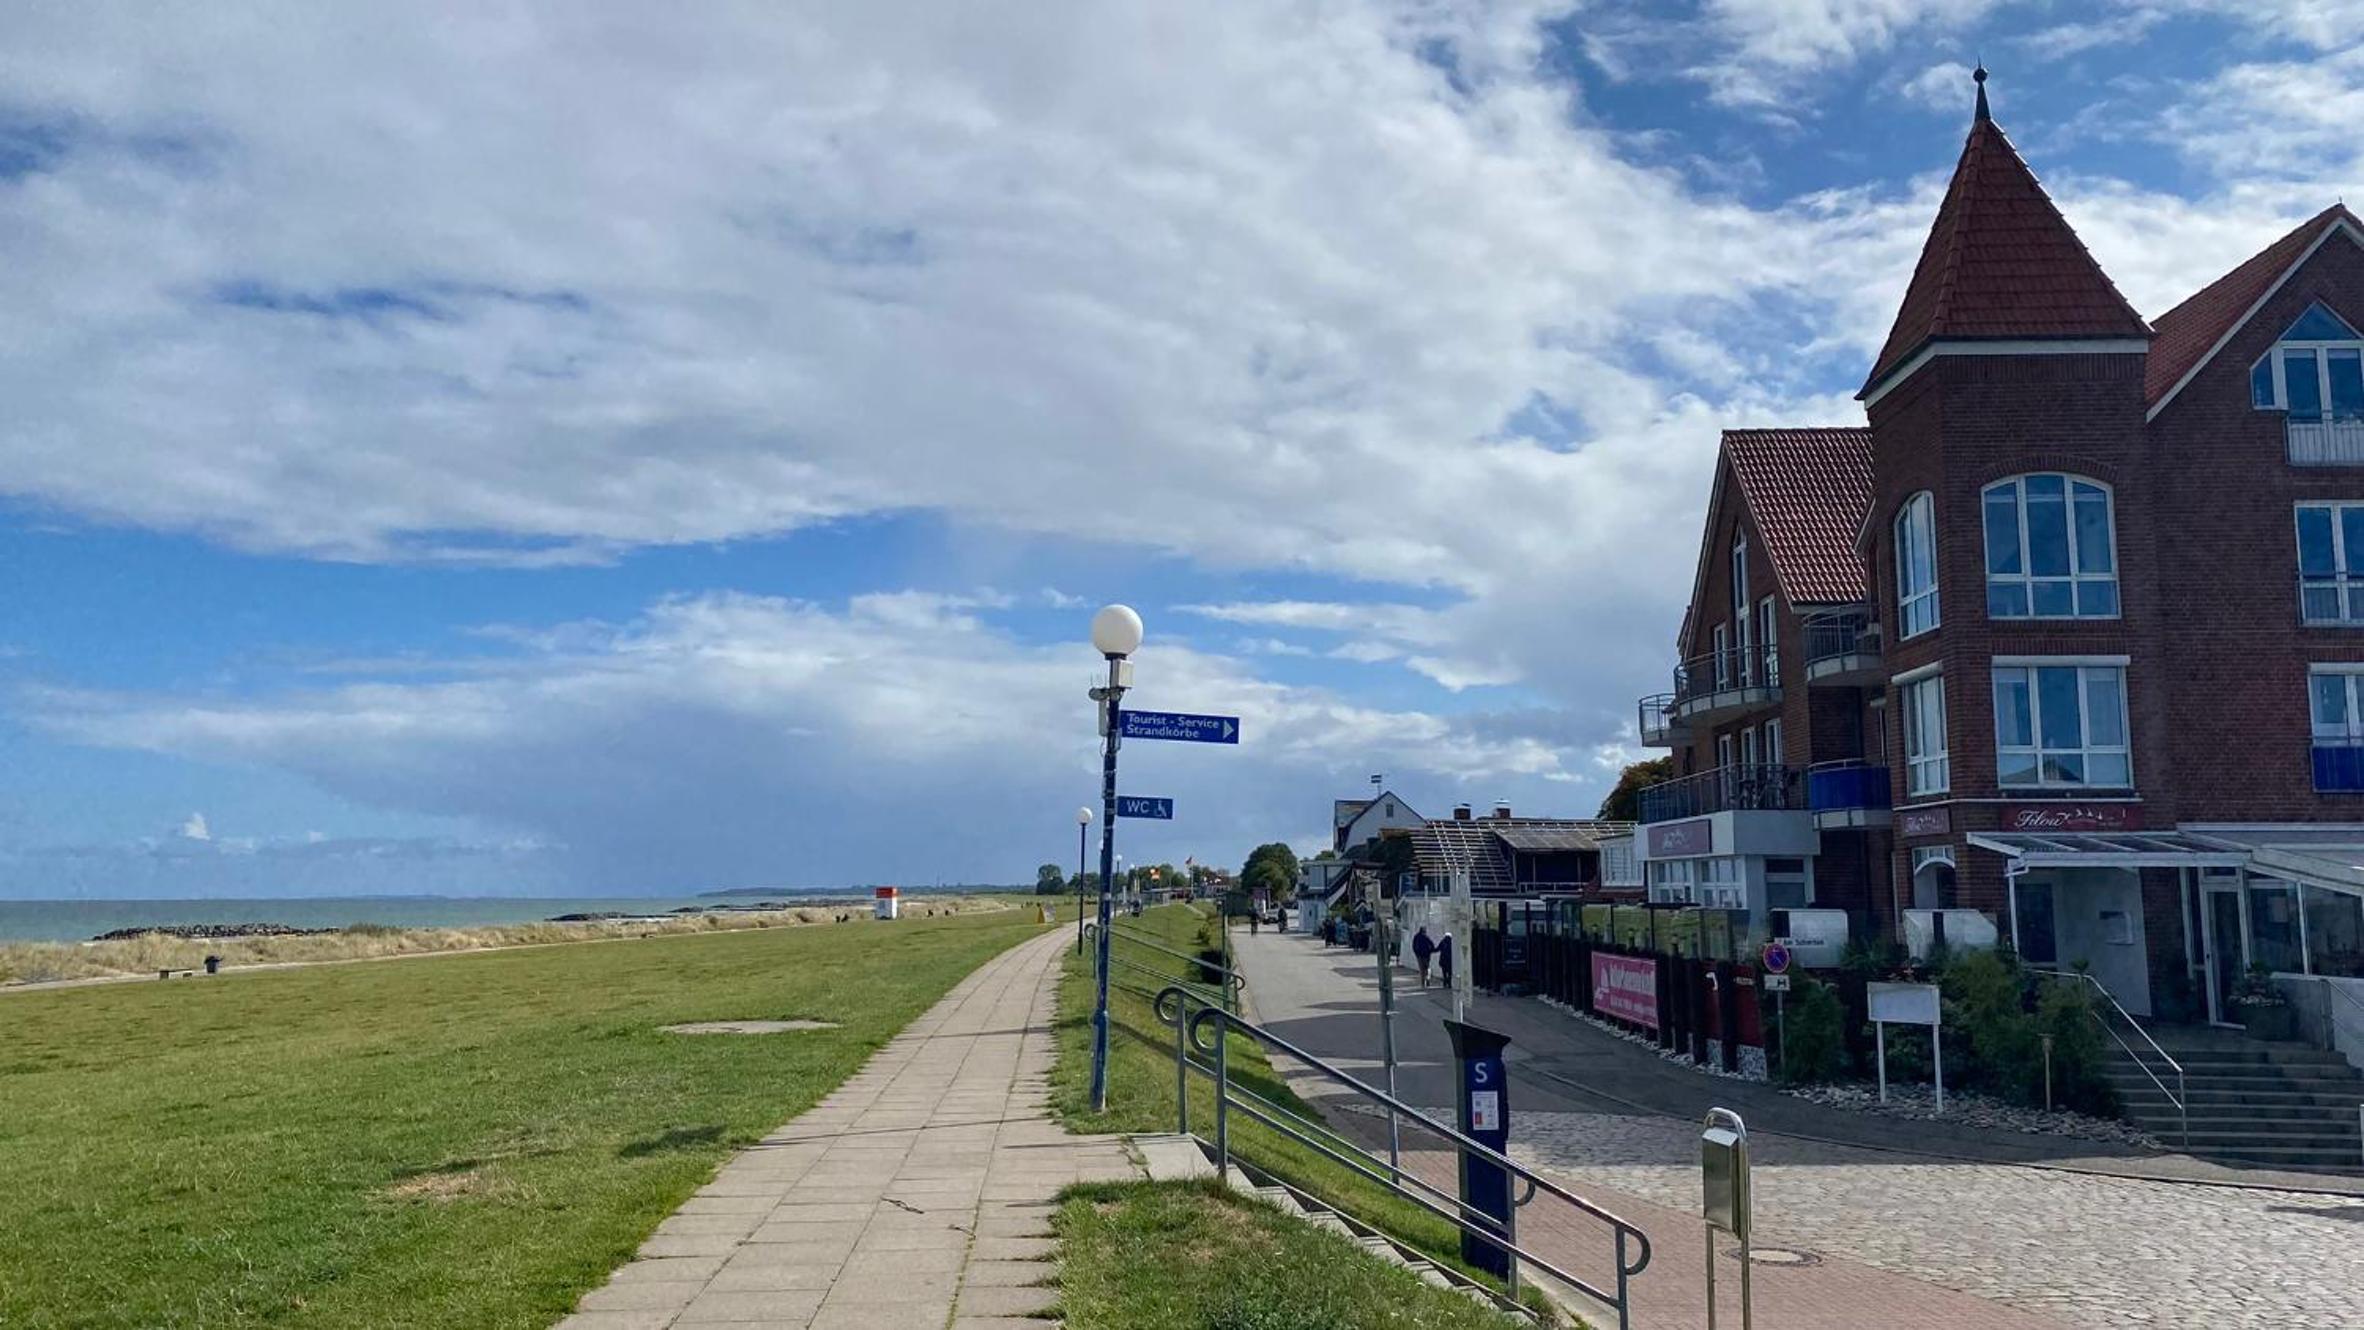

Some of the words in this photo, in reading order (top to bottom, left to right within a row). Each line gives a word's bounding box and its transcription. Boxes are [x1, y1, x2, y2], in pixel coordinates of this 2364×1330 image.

[1126, 713, 1167, 726] Tourist
[1177, 716, 1219, 729] Service
[1126, 724, 1201, 738] Strandkörbe
[1126, 800, 1150, 813] WC
[1474, 1062, 1488, 1083] S
